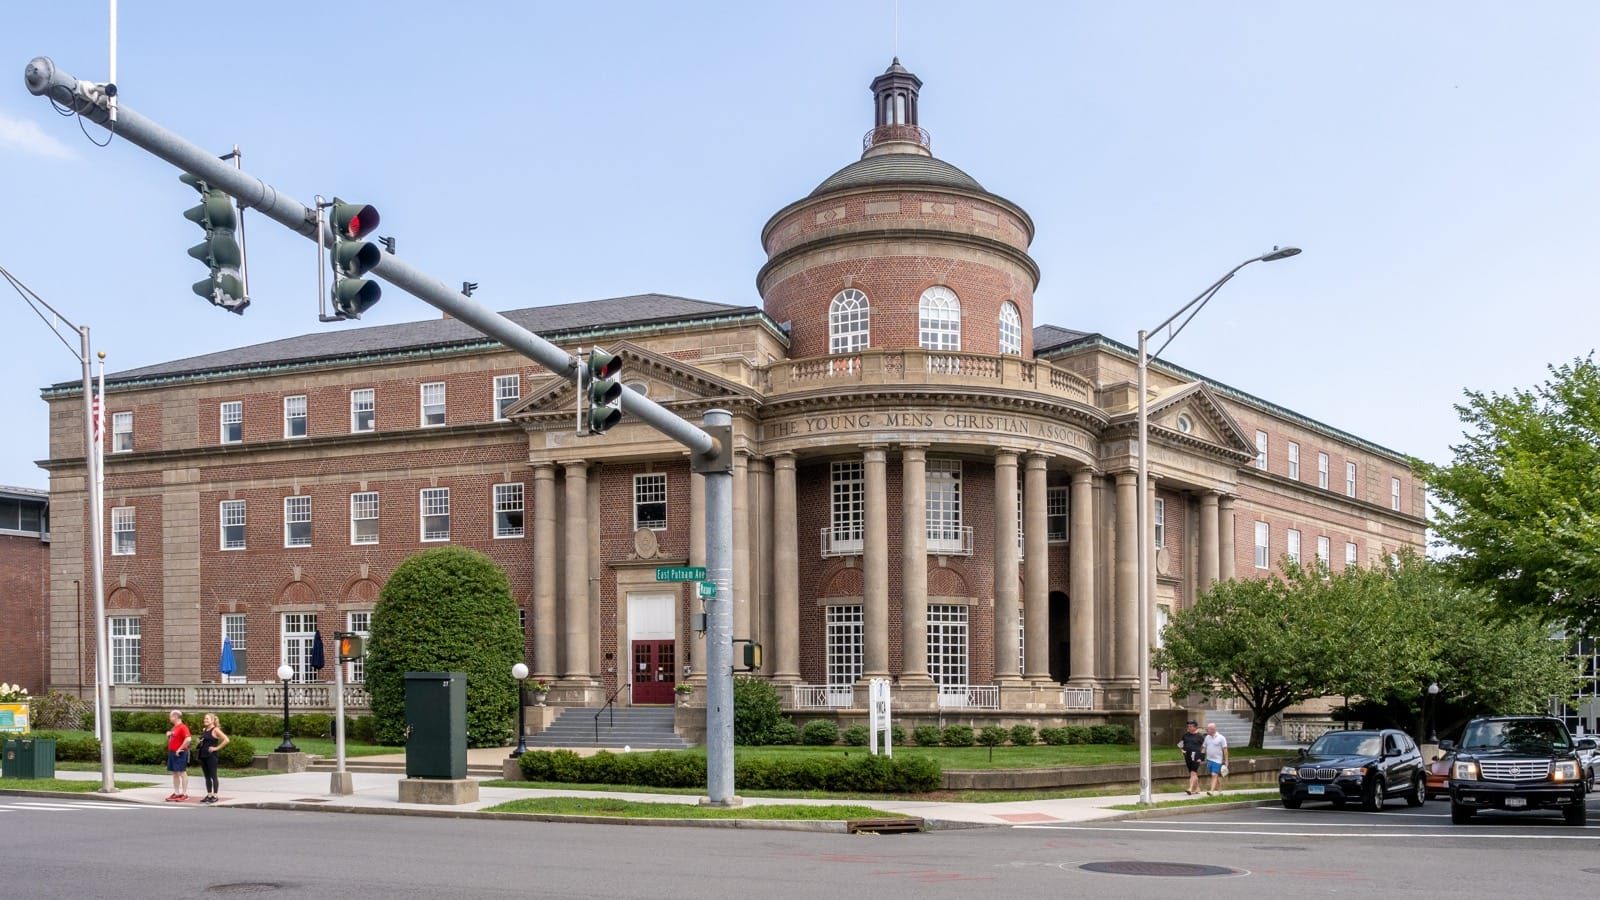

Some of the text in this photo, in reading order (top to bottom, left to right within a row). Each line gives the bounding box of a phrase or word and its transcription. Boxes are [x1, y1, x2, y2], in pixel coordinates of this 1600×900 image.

[770, 421, 798, 438] THE
[806, 414, 870, 432] YOUNG
[886, 412, 933, 427] MENS
[943, 414, 1029, 434] CHRISTIAN
[657, 569, 705, 579] East Putnam Ave
